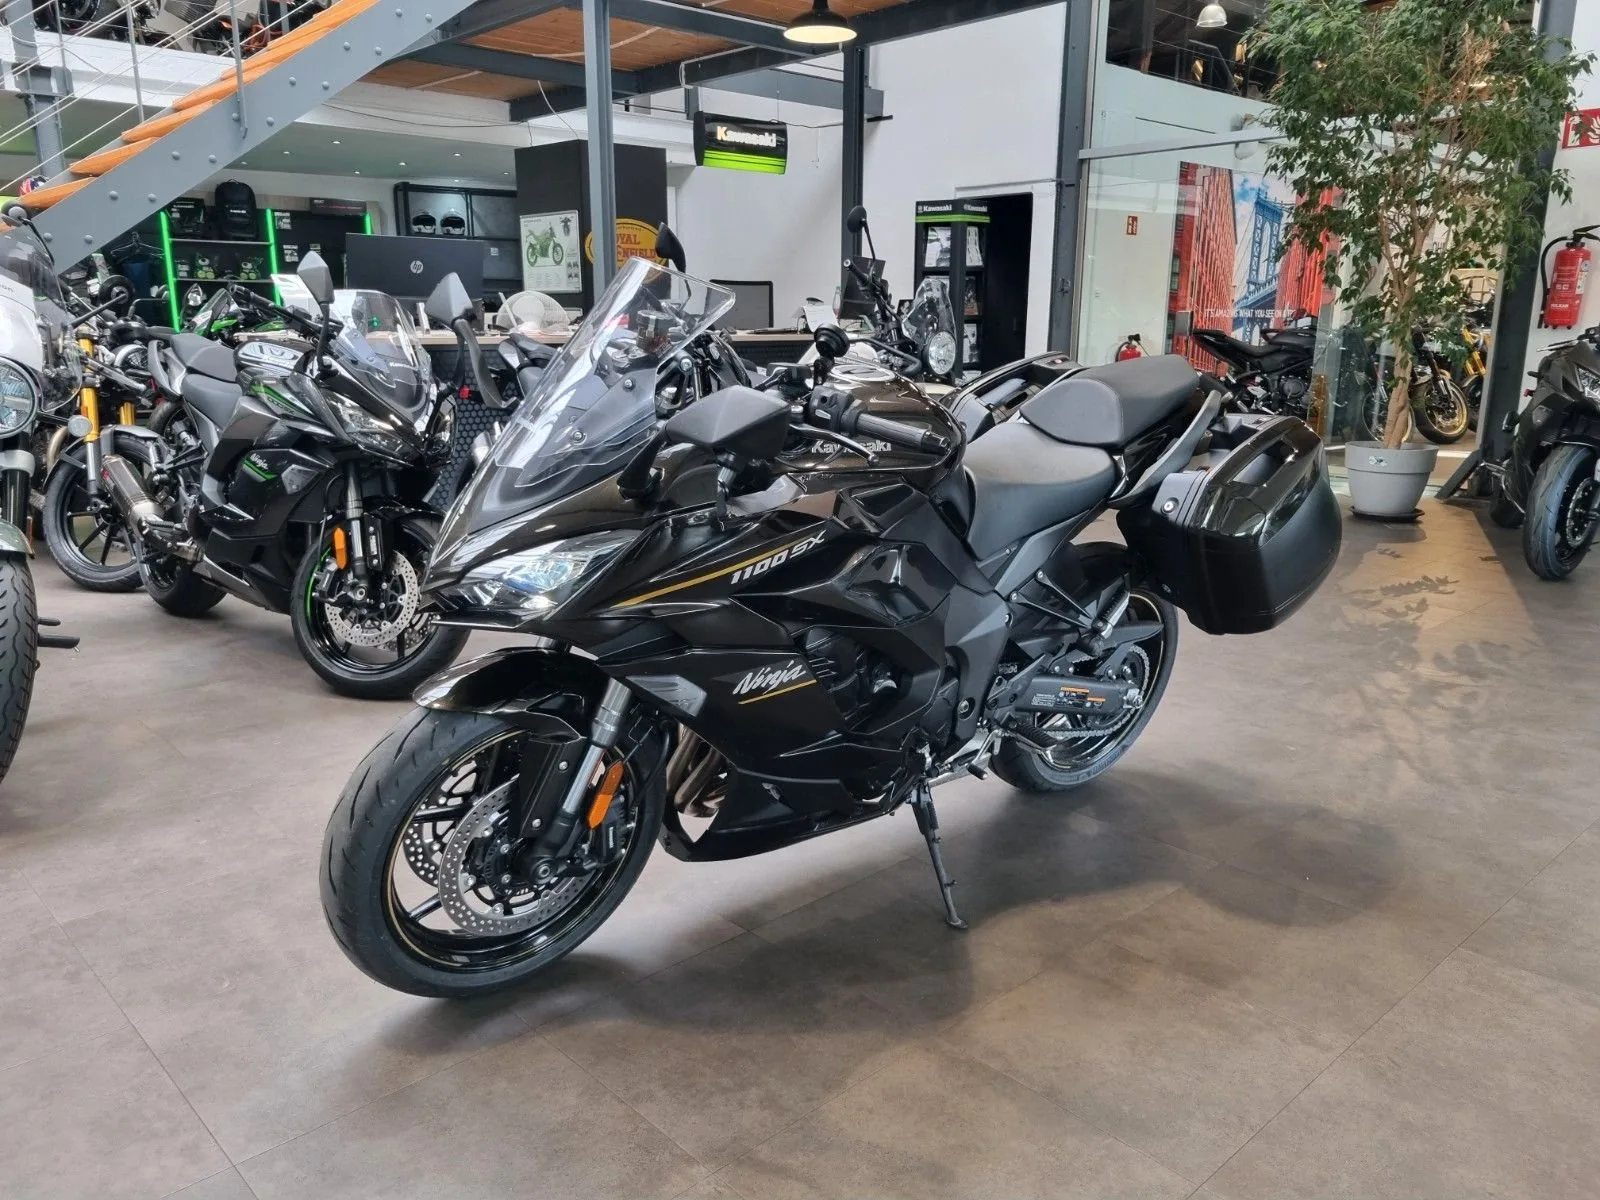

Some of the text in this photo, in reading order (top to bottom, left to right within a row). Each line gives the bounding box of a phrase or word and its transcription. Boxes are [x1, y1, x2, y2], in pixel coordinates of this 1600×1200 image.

[716, 125, 776, 147] Kawasaki
[923, 204, 953, 212] Kawasaki
[1239, 308, 1253, 318] WHAT
[1254, 308, 1265, 318] YOU
[1265, 309, 1275, 318] SEE
[811, 439, 892, 453] Kaaki
[250, 453, 268, 469] Ninja
[732, 660, 806, 695] Ninja
